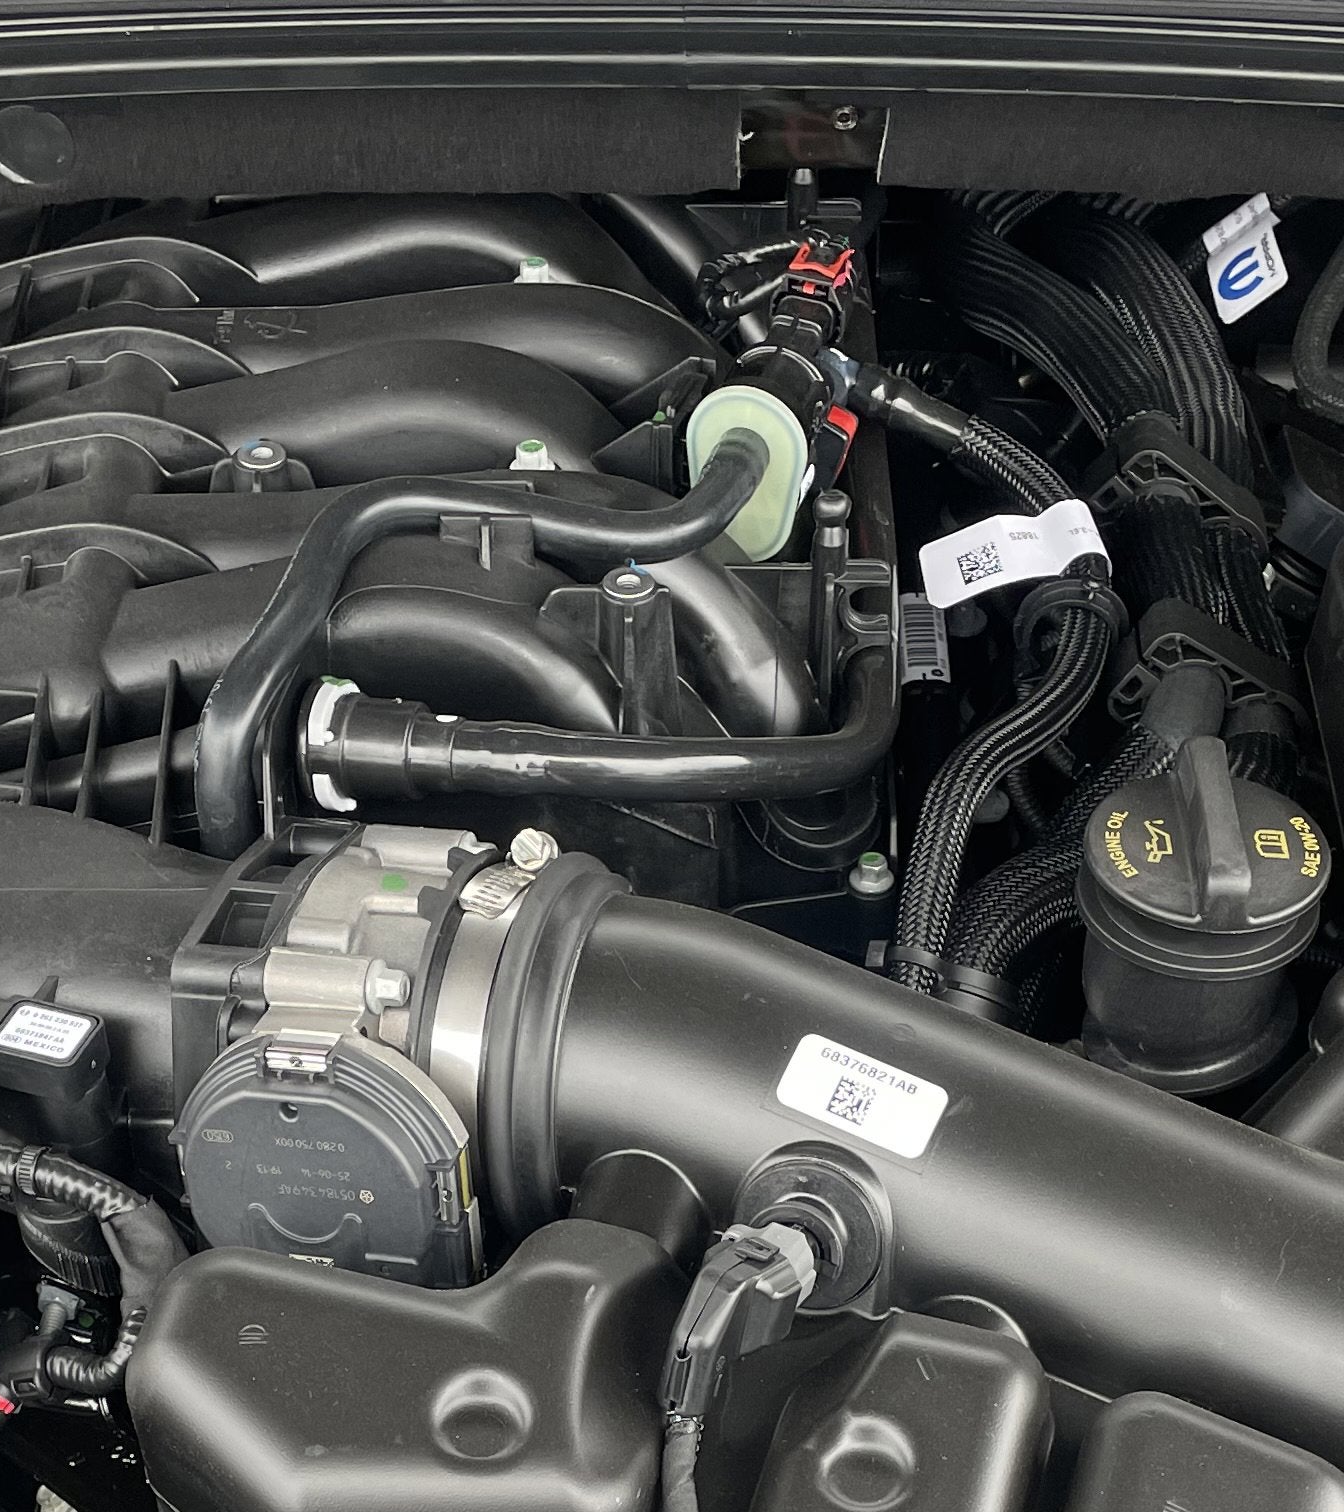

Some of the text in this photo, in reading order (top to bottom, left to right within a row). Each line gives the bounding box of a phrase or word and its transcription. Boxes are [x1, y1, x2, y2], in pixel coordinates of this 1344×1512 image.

[1105, 810, 1140, 879] ENGINE OIL
[1289, 816, 1322, 878] SAE 0W-20
[23, 1039, 65, 1053] MEXICO
[820, 1047, 918, 1095] 68376821AB
